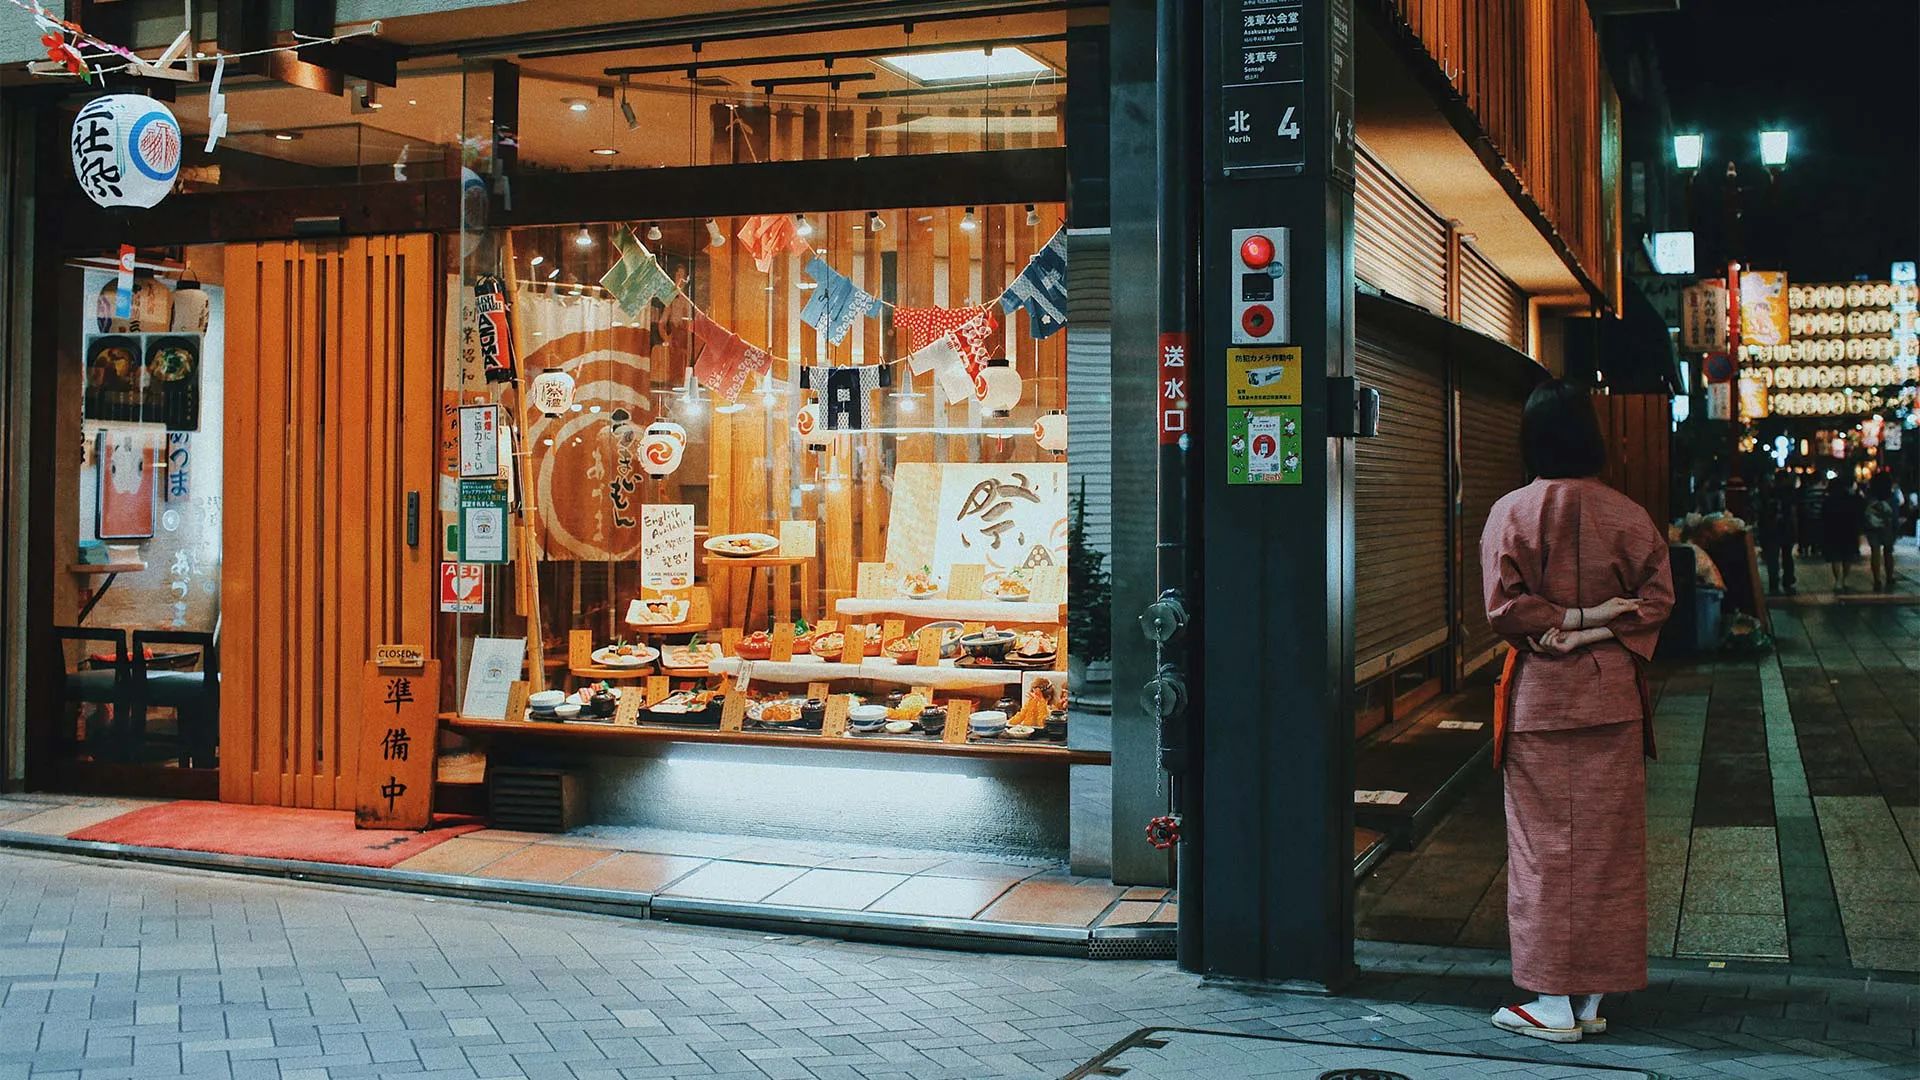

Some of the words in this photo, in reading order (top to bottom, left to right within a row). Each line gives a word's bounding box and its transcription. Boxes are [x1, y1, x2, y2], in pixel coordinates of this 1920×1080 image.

[1244, 12, 1299, 27] 浅草公会堂
[1268, 27, 1286, 35] public
[1244, 51, 1277, 64] 浅草寺
[1229, 110, 1251, 133] 北
[1277, 106, 1300, 140] 4
[1229, 135, 1251, 144] North
[1235, 353, 1294, 363] 防犯カメラ作動中
[1164, 346, 1185, 432] 送水口
[483, 410, 492, 440] 禁煙に
[474, 411, 483, 471] ご協力下さい
[644, 507, 681, 528] English
[445, 565, 481, 577] AED
[378, 649, 411, 658] CLOSED
[380, 677, 414, 813] 準備中
